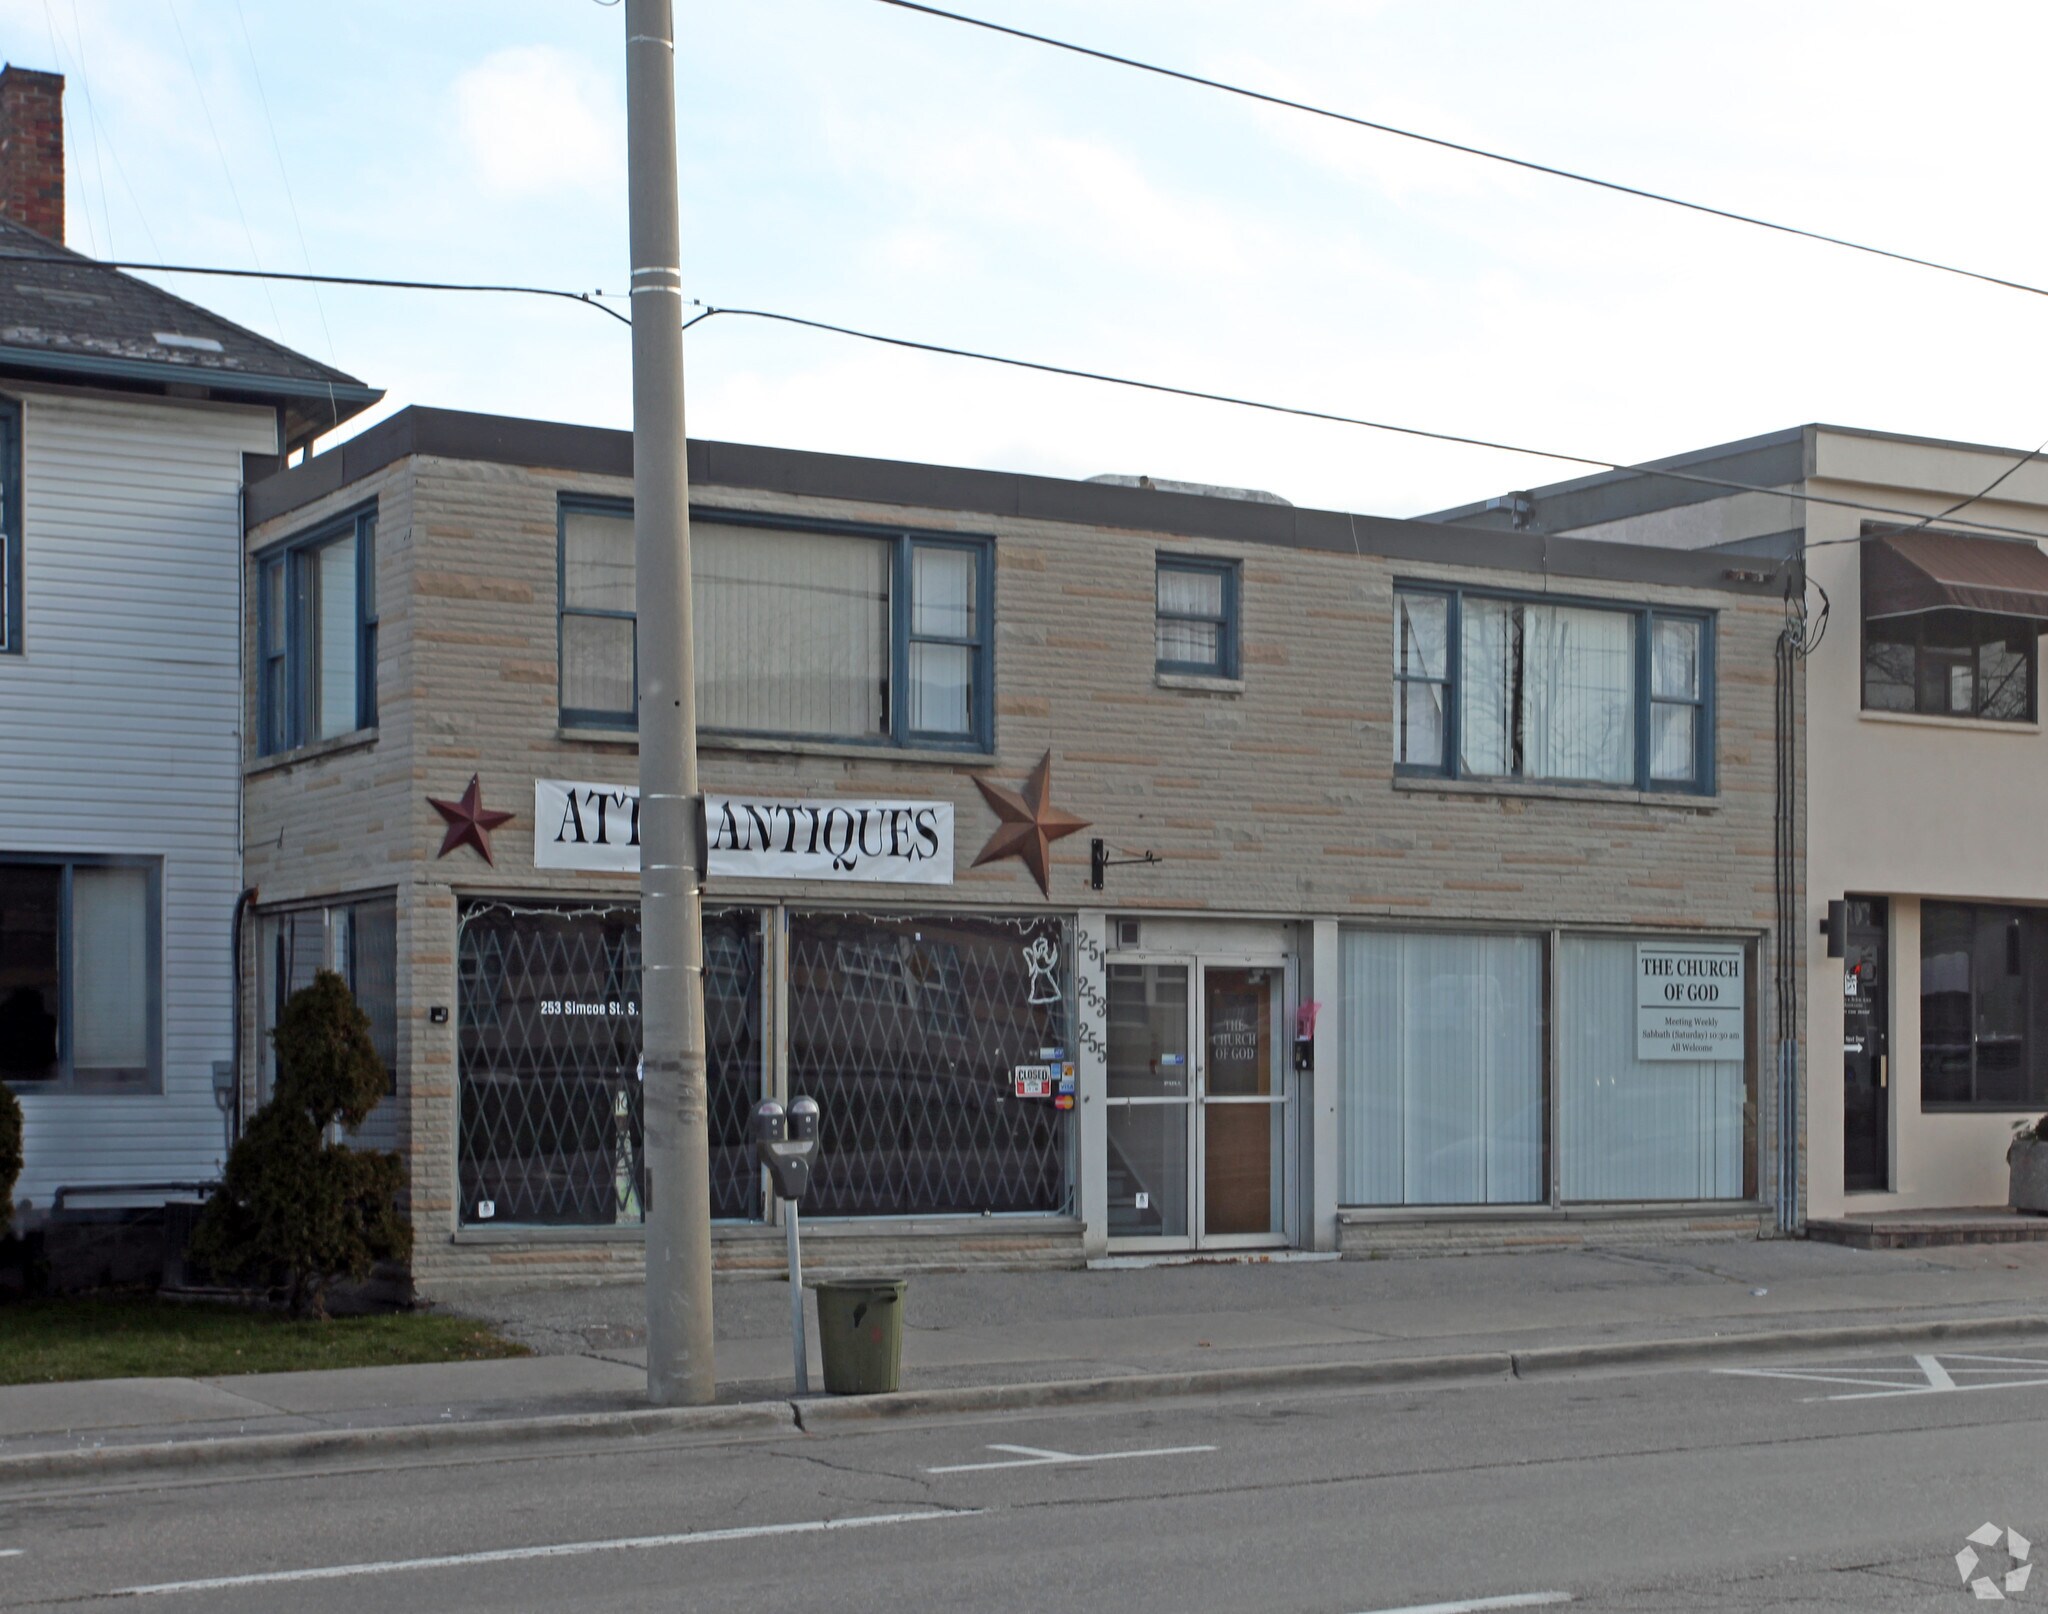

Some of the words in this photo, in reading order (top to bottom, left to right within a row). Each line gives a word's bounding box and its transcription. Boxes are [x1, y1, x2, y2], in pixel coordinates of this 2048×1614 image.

[554, 787, 641, 846] ATT
[709, 801, 941, 871] ANTIQUES
[1079, 929, 1105, 972] 251
[1641, 957, 1674, 976] THE
[1676, 959, 1740, 978] CHURCH
[1079, 975, 1106, 1018] 253
[1664, 983, 1685, 1001] OF
[1687, 983, 1719, 1002] GOD
[540, 1001, 562, 1015] 253
[564, 1001, 606, 1015] Simcoe
[609, 1001, 624, 1015] St.
[627, 1002, 639, 1016] S.
[1224, 1020, 1246, 1032] THE
[1664, 1017, 1693, 1027] Meeting
[1694, 1017, 1719, 1028] Weekly
[1213, 1032, 1257, 1046] CHURCH
[1642, 1030, 1671, 1039] Sabbath
[1079, 1021, 1107, 1064] 255
[1671, 1043, 1681, 1052] All
[1682, 1043, 1713, 1053] Welcome
[1215, 1047, 1230, 1060] OF
[1231, 1047, 1254, 1060] GOD
[1018, 1069, 1048, 1081] CLOSED
